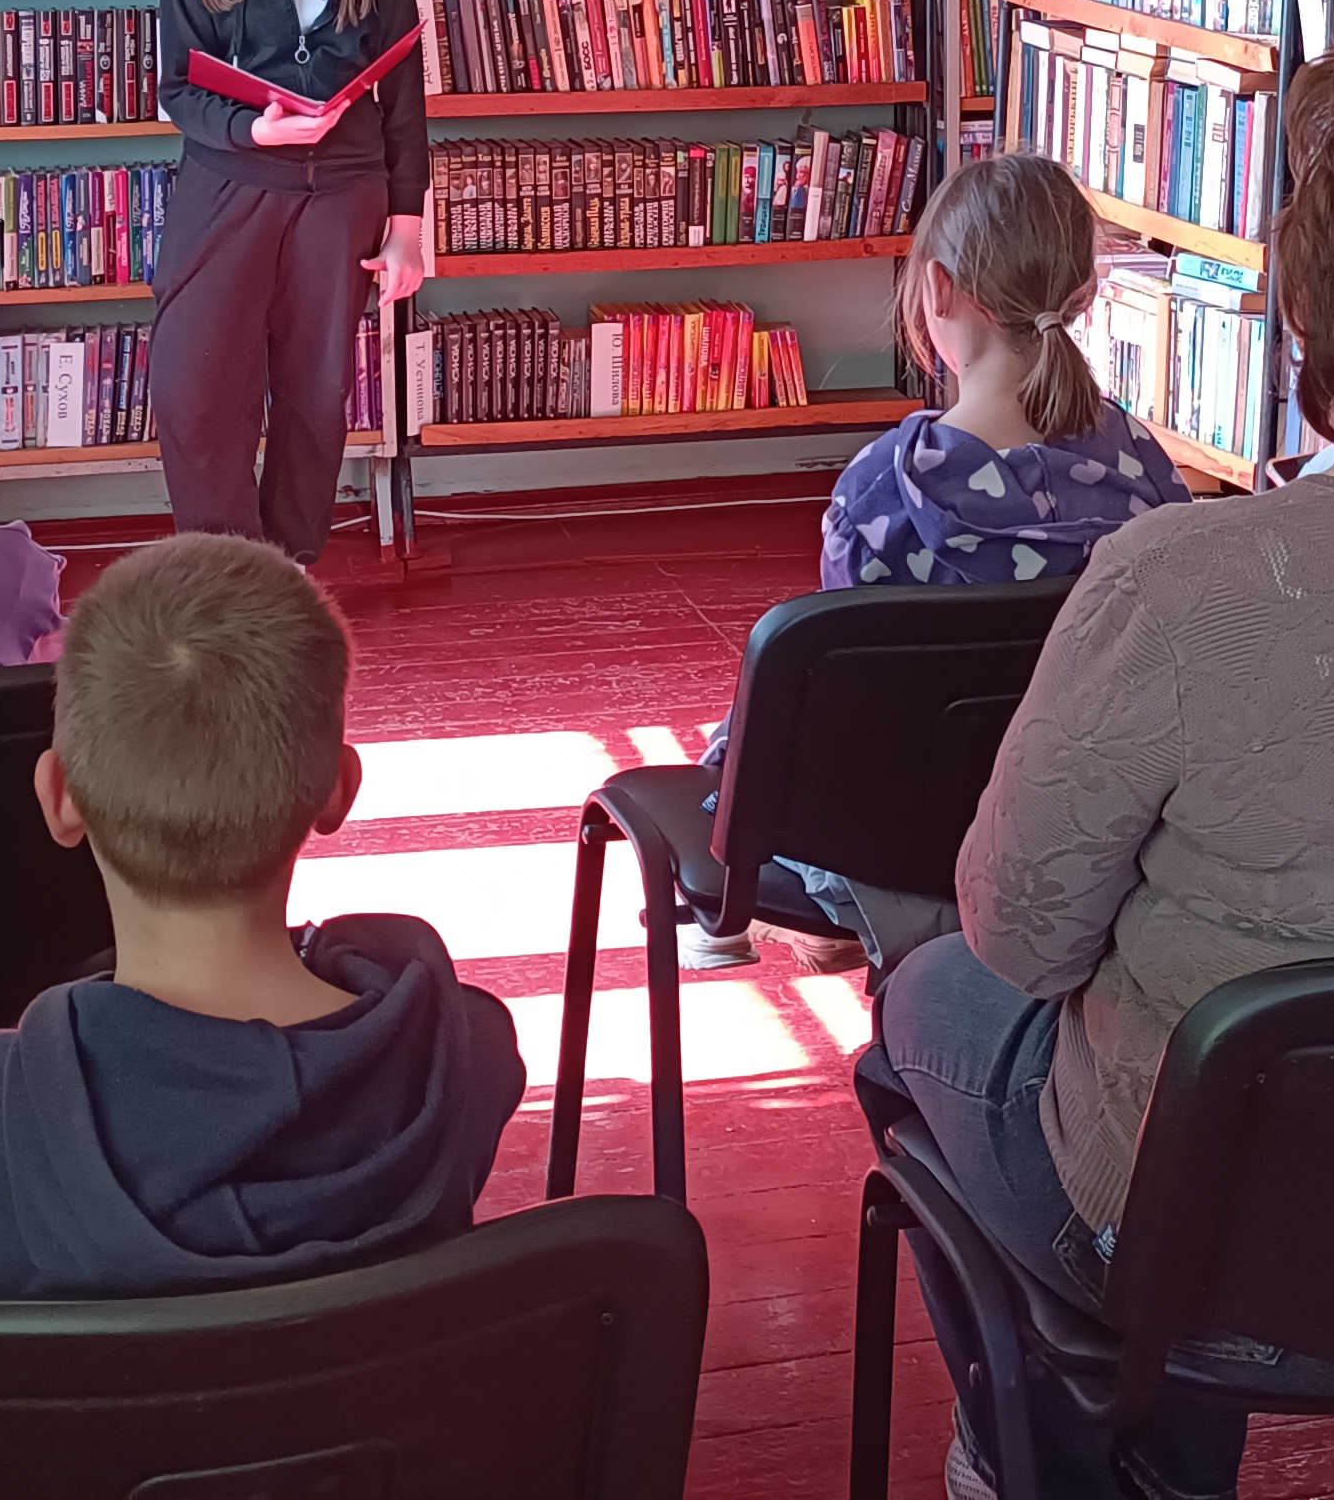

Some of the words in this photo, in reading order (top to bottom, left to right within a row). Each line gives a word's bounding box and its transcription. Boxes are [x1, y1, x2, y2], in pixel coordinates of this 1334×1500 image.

[59, 355, 73, 368] Е.
[416, 343, 427, 354] Т.
[55, 373, 72, 419] Сухов
[415, 360, 427, 421] Устинова
[610, 354, 623, 406] Шилова
